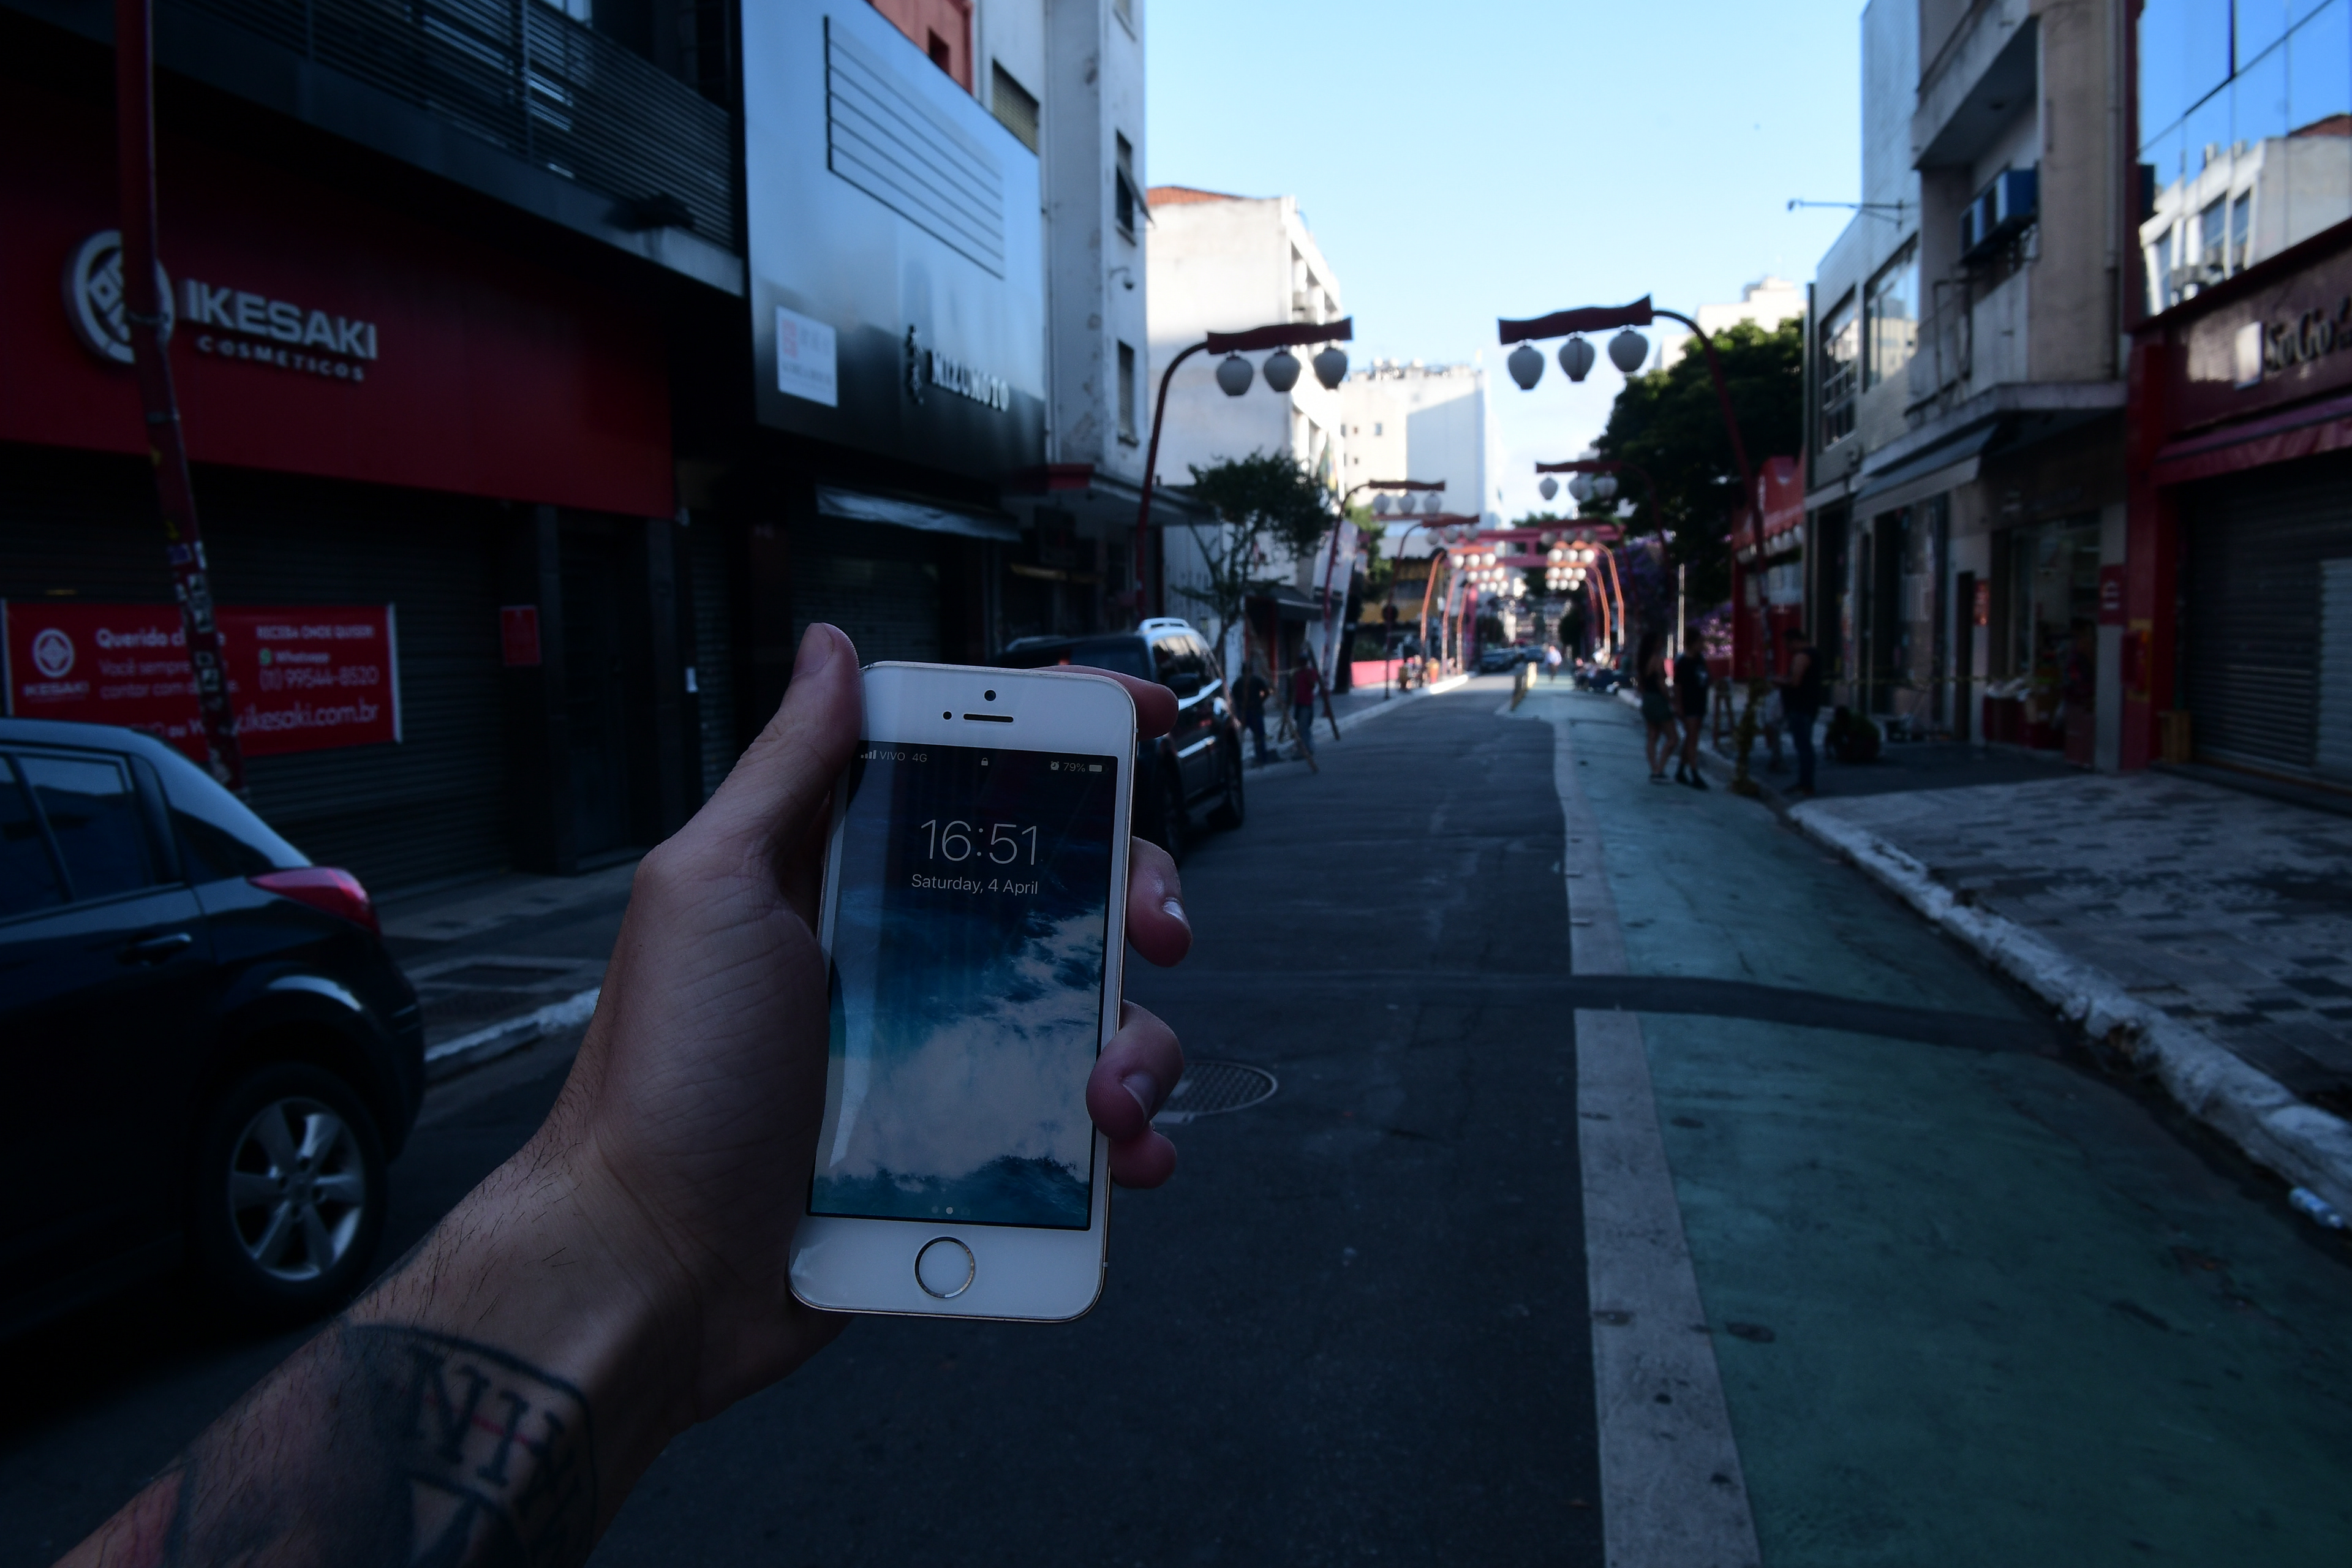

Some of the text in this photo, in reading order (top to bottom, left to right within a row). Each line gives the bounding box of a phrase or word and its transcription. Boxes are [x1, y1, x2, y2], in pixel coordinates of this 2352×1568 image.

[177, 277, 378, 361] IKESAKI
[95, 626, 169, 650] Querido
[880, 751, 927, 762] VIVO 4G
[1063, 762, 1085, 772] 79%
[921, 819, 1037, 865] 16:51
[911, 873, 1038, 896] Saturday, 4 April
